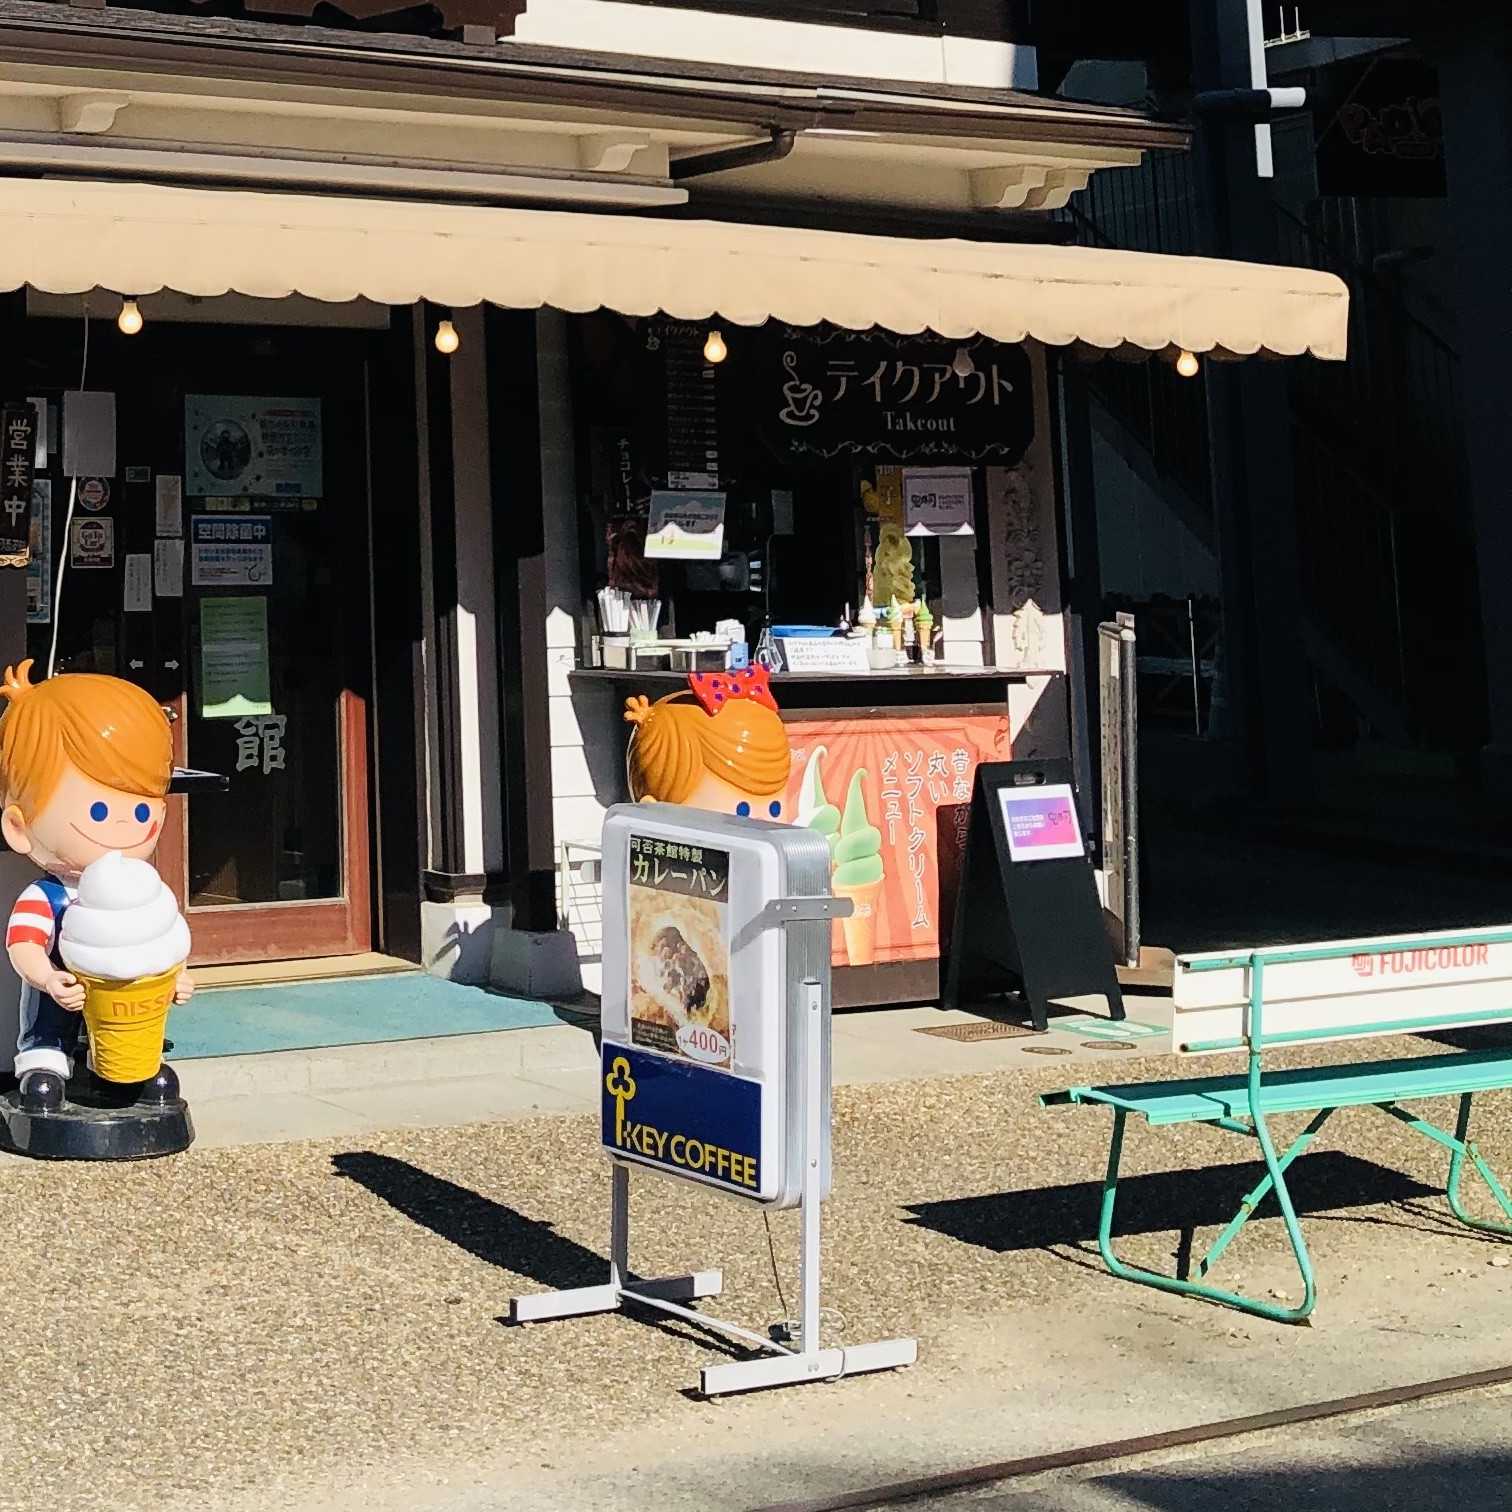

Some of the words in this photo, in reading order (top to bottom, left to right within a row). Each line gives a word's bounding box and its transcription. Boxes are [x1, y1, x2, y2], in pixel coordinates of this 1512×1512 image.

[826, 361, 1014, 405] テイクアウト
[883, 411, 956, 432] Takeout
[4, 418, 31, 528] 営業中
[881, 751, 902, 846] メニュー
[927, 750, 949, 804] 丸い
[630, 837, 703, 865] 可否茶館特製
[904, 750, 930, 928] ソフトクリーム
[632, 853, 727, 897] カレーパン
[1379, 944, 1489, 975] FUJICOLOR
[623, 1120, 669, 1159] KEY
[670, 1134, 757, 1188] COFFEE
